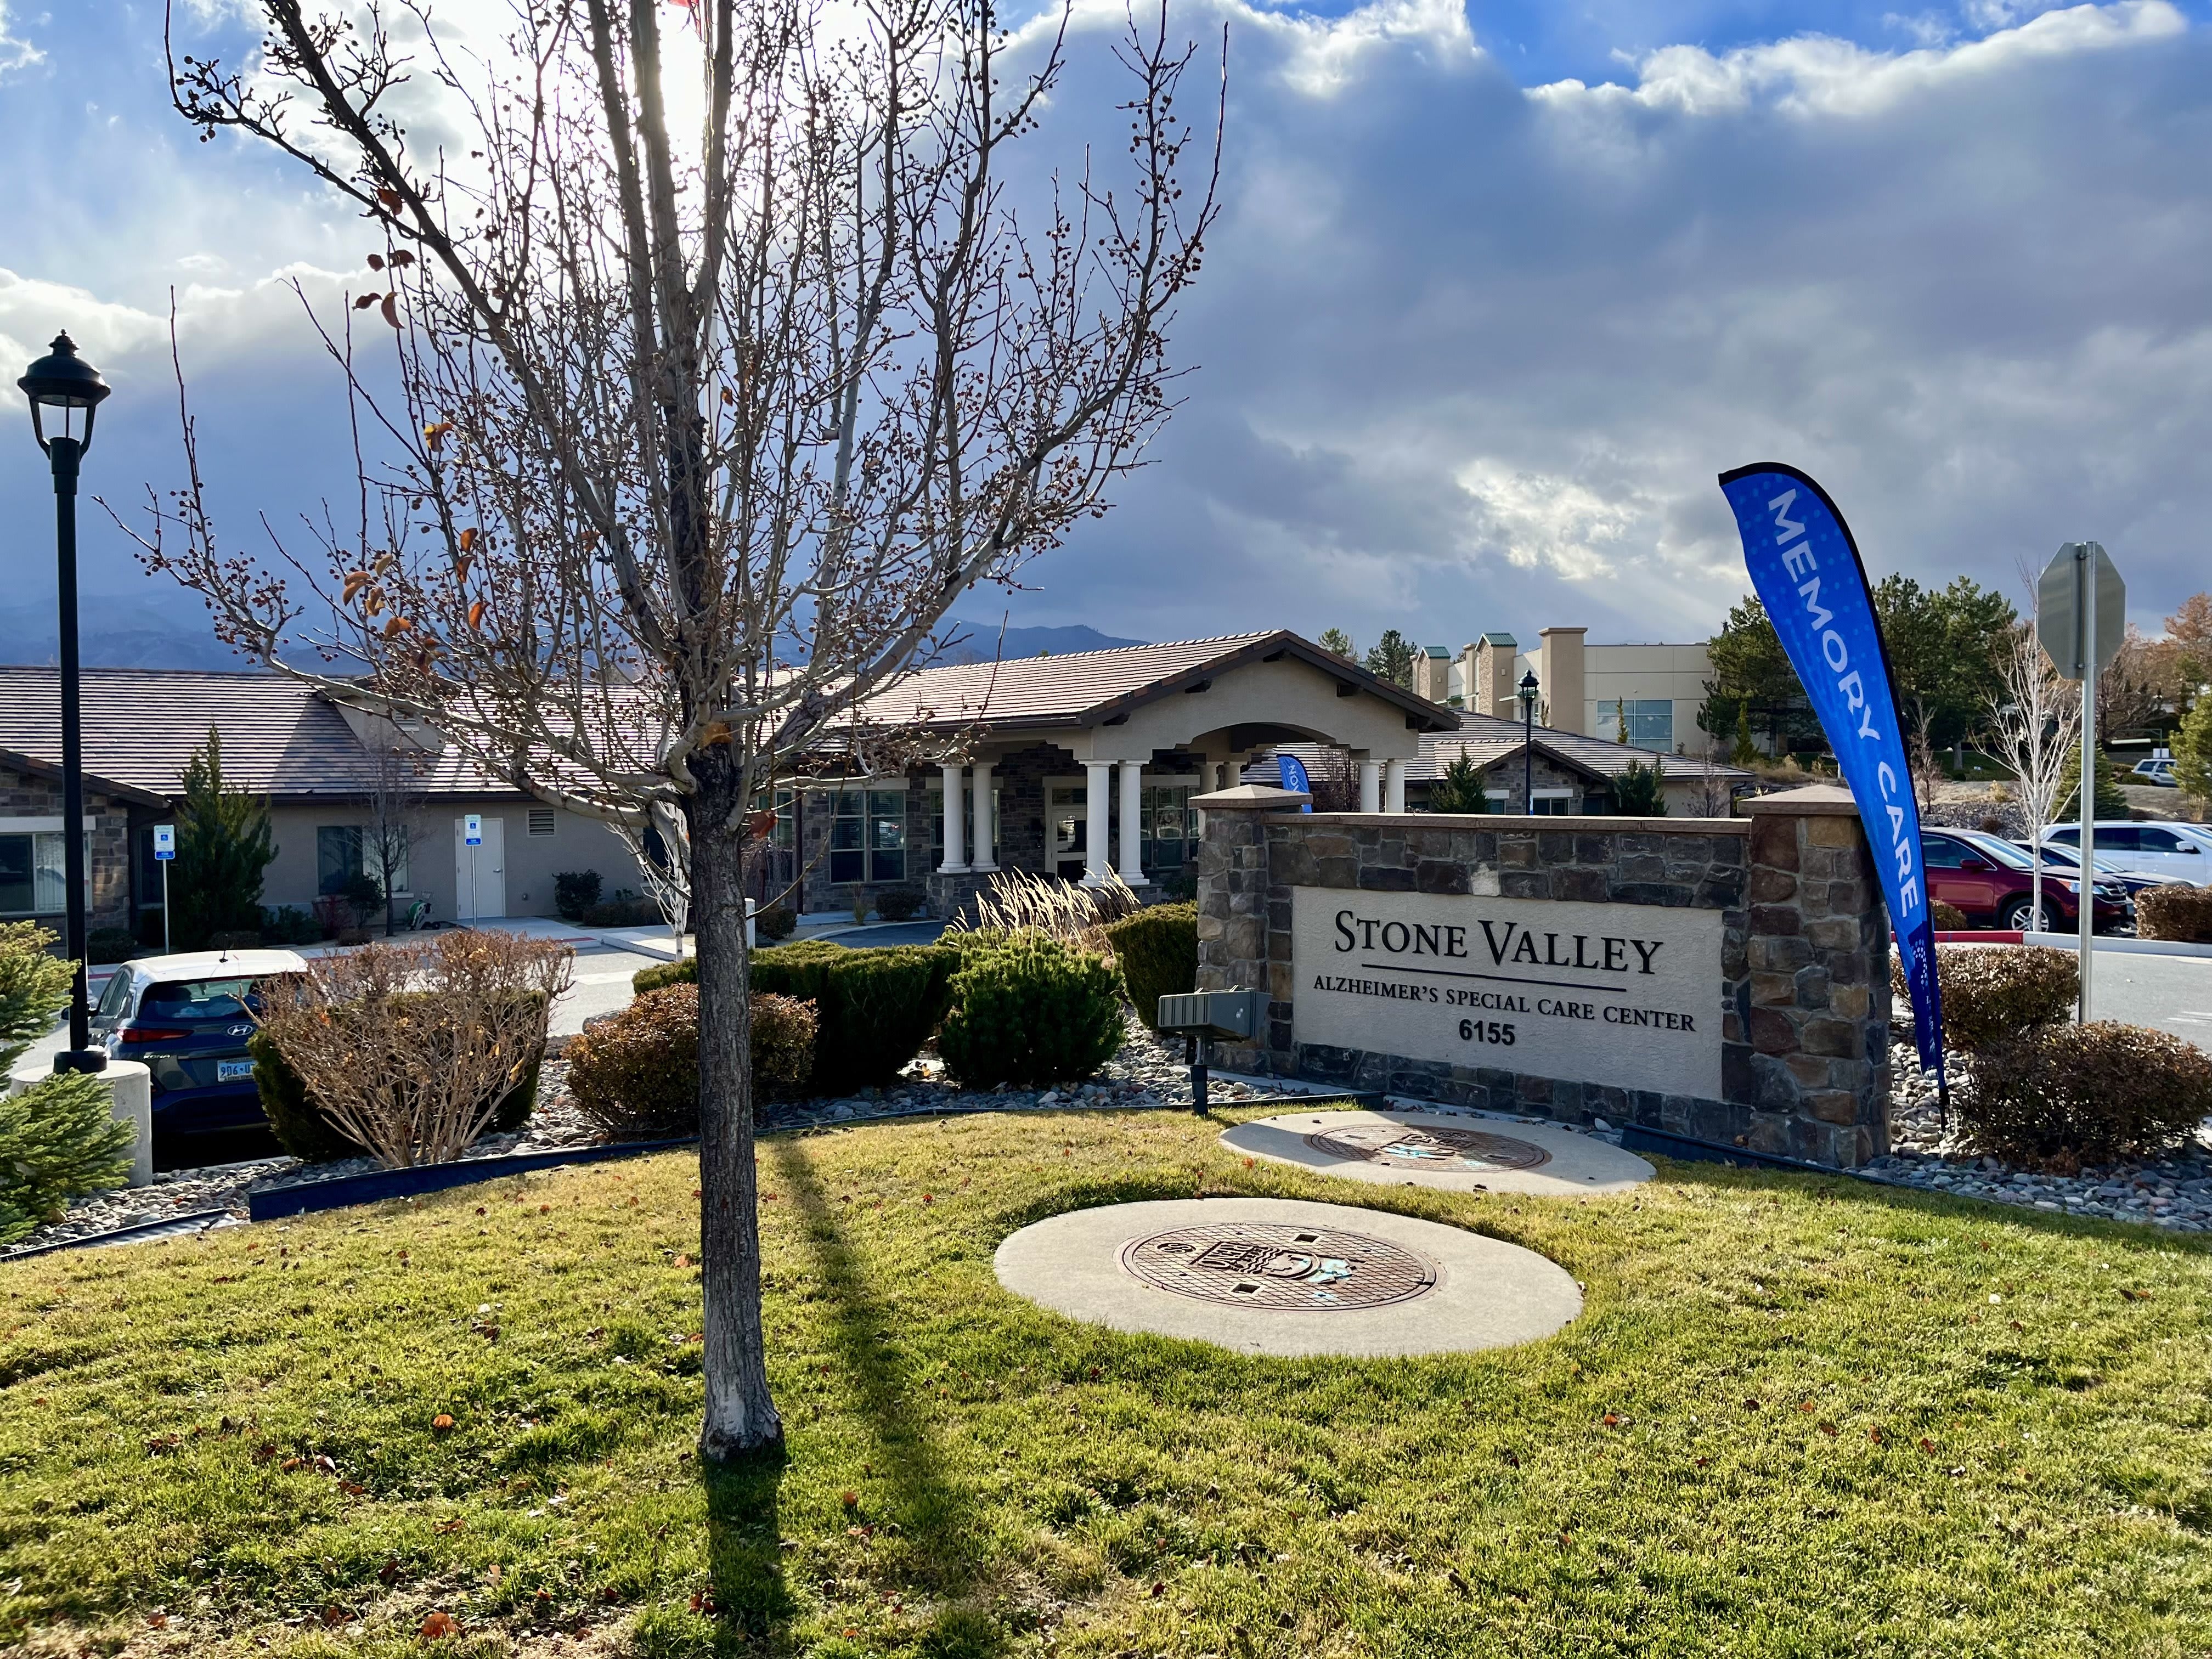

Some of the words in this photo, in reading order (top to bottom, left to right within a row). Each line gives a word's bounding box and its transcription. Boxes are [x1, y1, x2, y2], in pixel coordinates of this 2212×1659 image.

[1768, 488, 1881, 741] MEMORY
[1878, 760, 1919, 918] CARE
[1334, 910, 1468, 958] STONE
[1477, 919, 1664, 975] VALLEY
[1312, 974, 1438, 1003] ALZHEIMER'S
[1446, 988, 1531, 1013] SPECIAL
[1537, 998, 1595, 1020] CARE
[1602, 1006, 1697, 1032] CENTER
[1458, 1018, 1516, 1047] 6155
[1198, 1242, 1254, 1270] RENO
